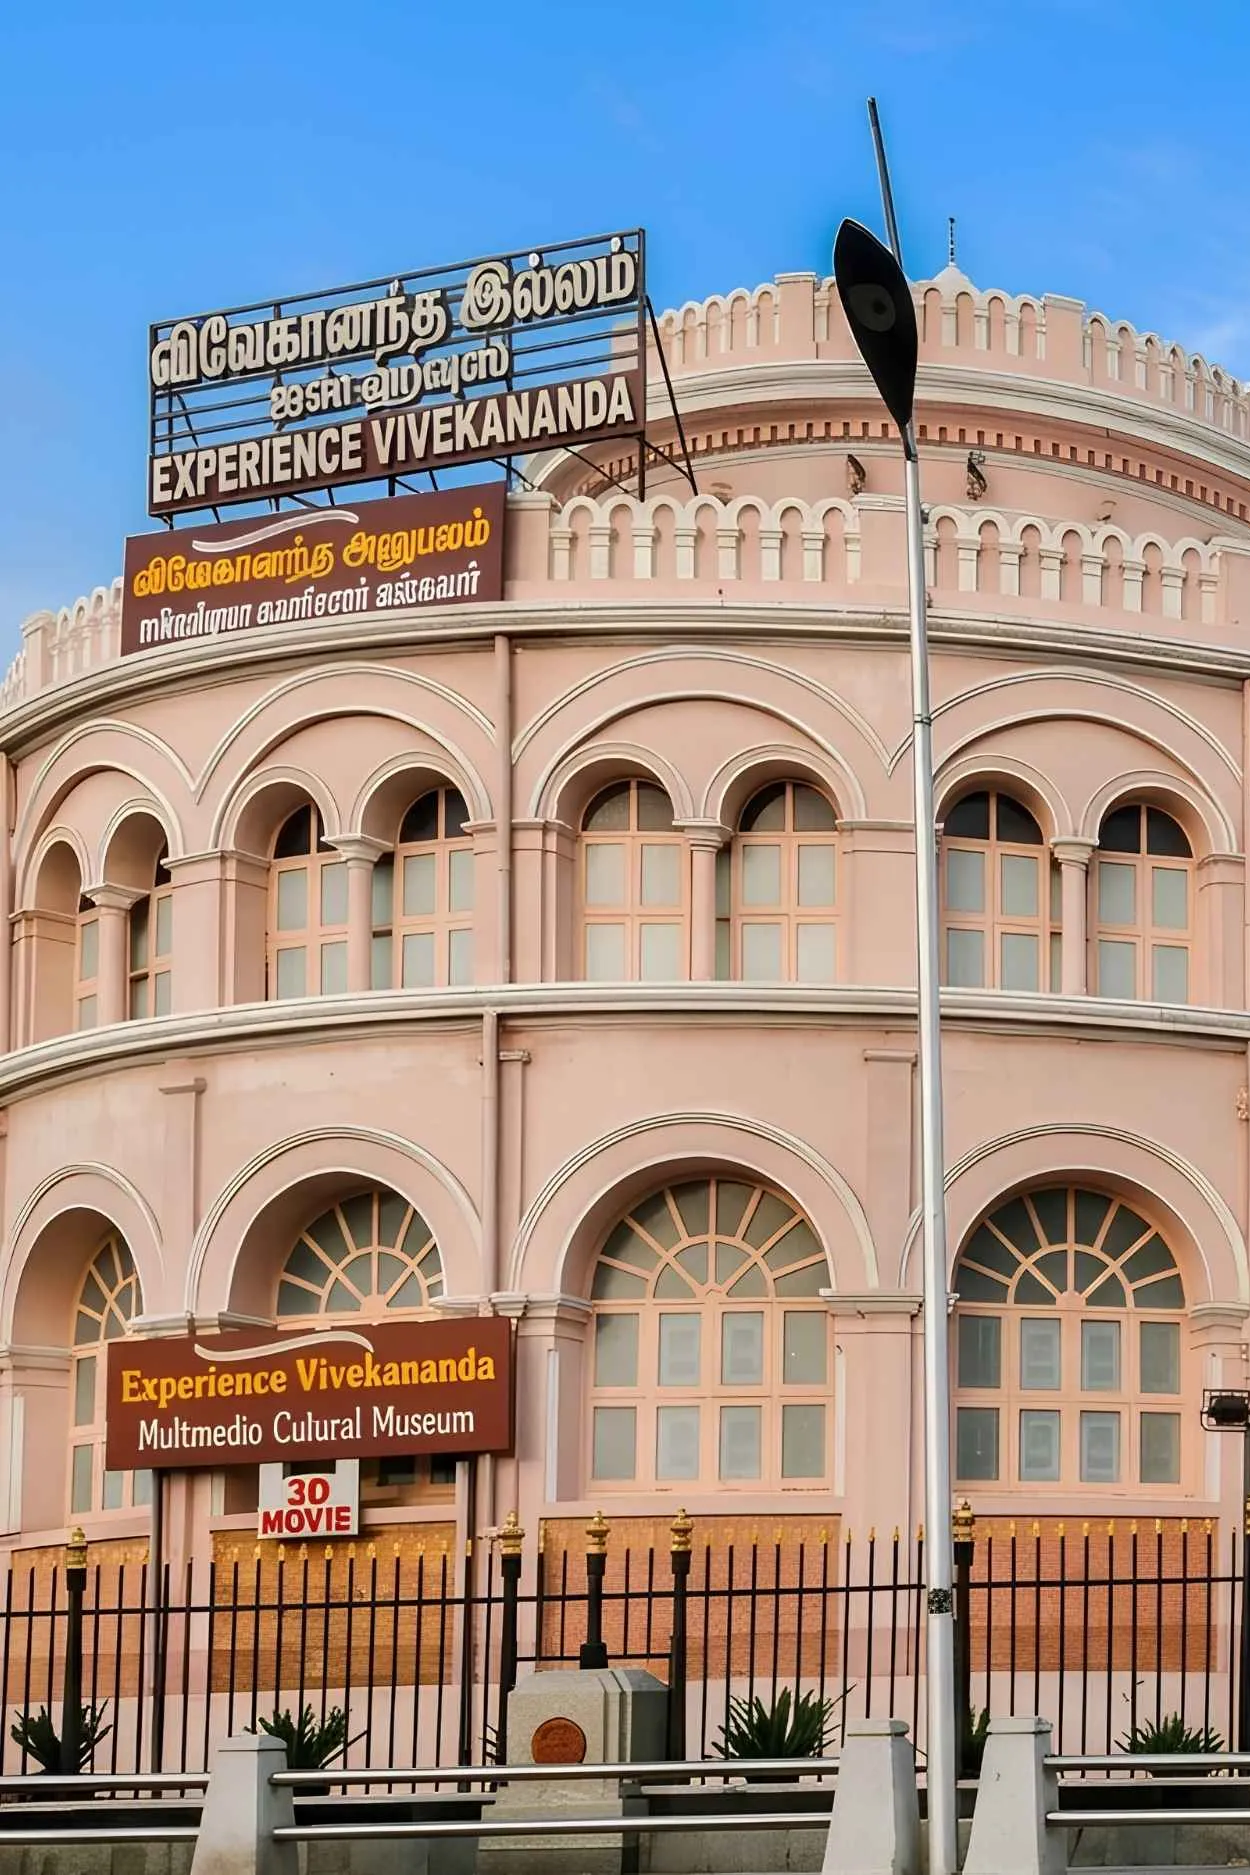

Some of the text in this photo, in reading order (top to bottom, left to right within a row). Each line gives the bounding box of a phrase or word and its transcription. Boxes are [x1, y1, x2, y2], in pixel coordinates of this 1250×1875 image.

[459, 236, 638, 329] இல்லம்
[151, 376, 636, 504] EXPERIENCE VIVEKANANDA
[121, 1347, 496, 1408] Experience Vivekananda
[372, 1405, 475, 1437] Museum
[262, 1506, 351, 1534] MOVIE
